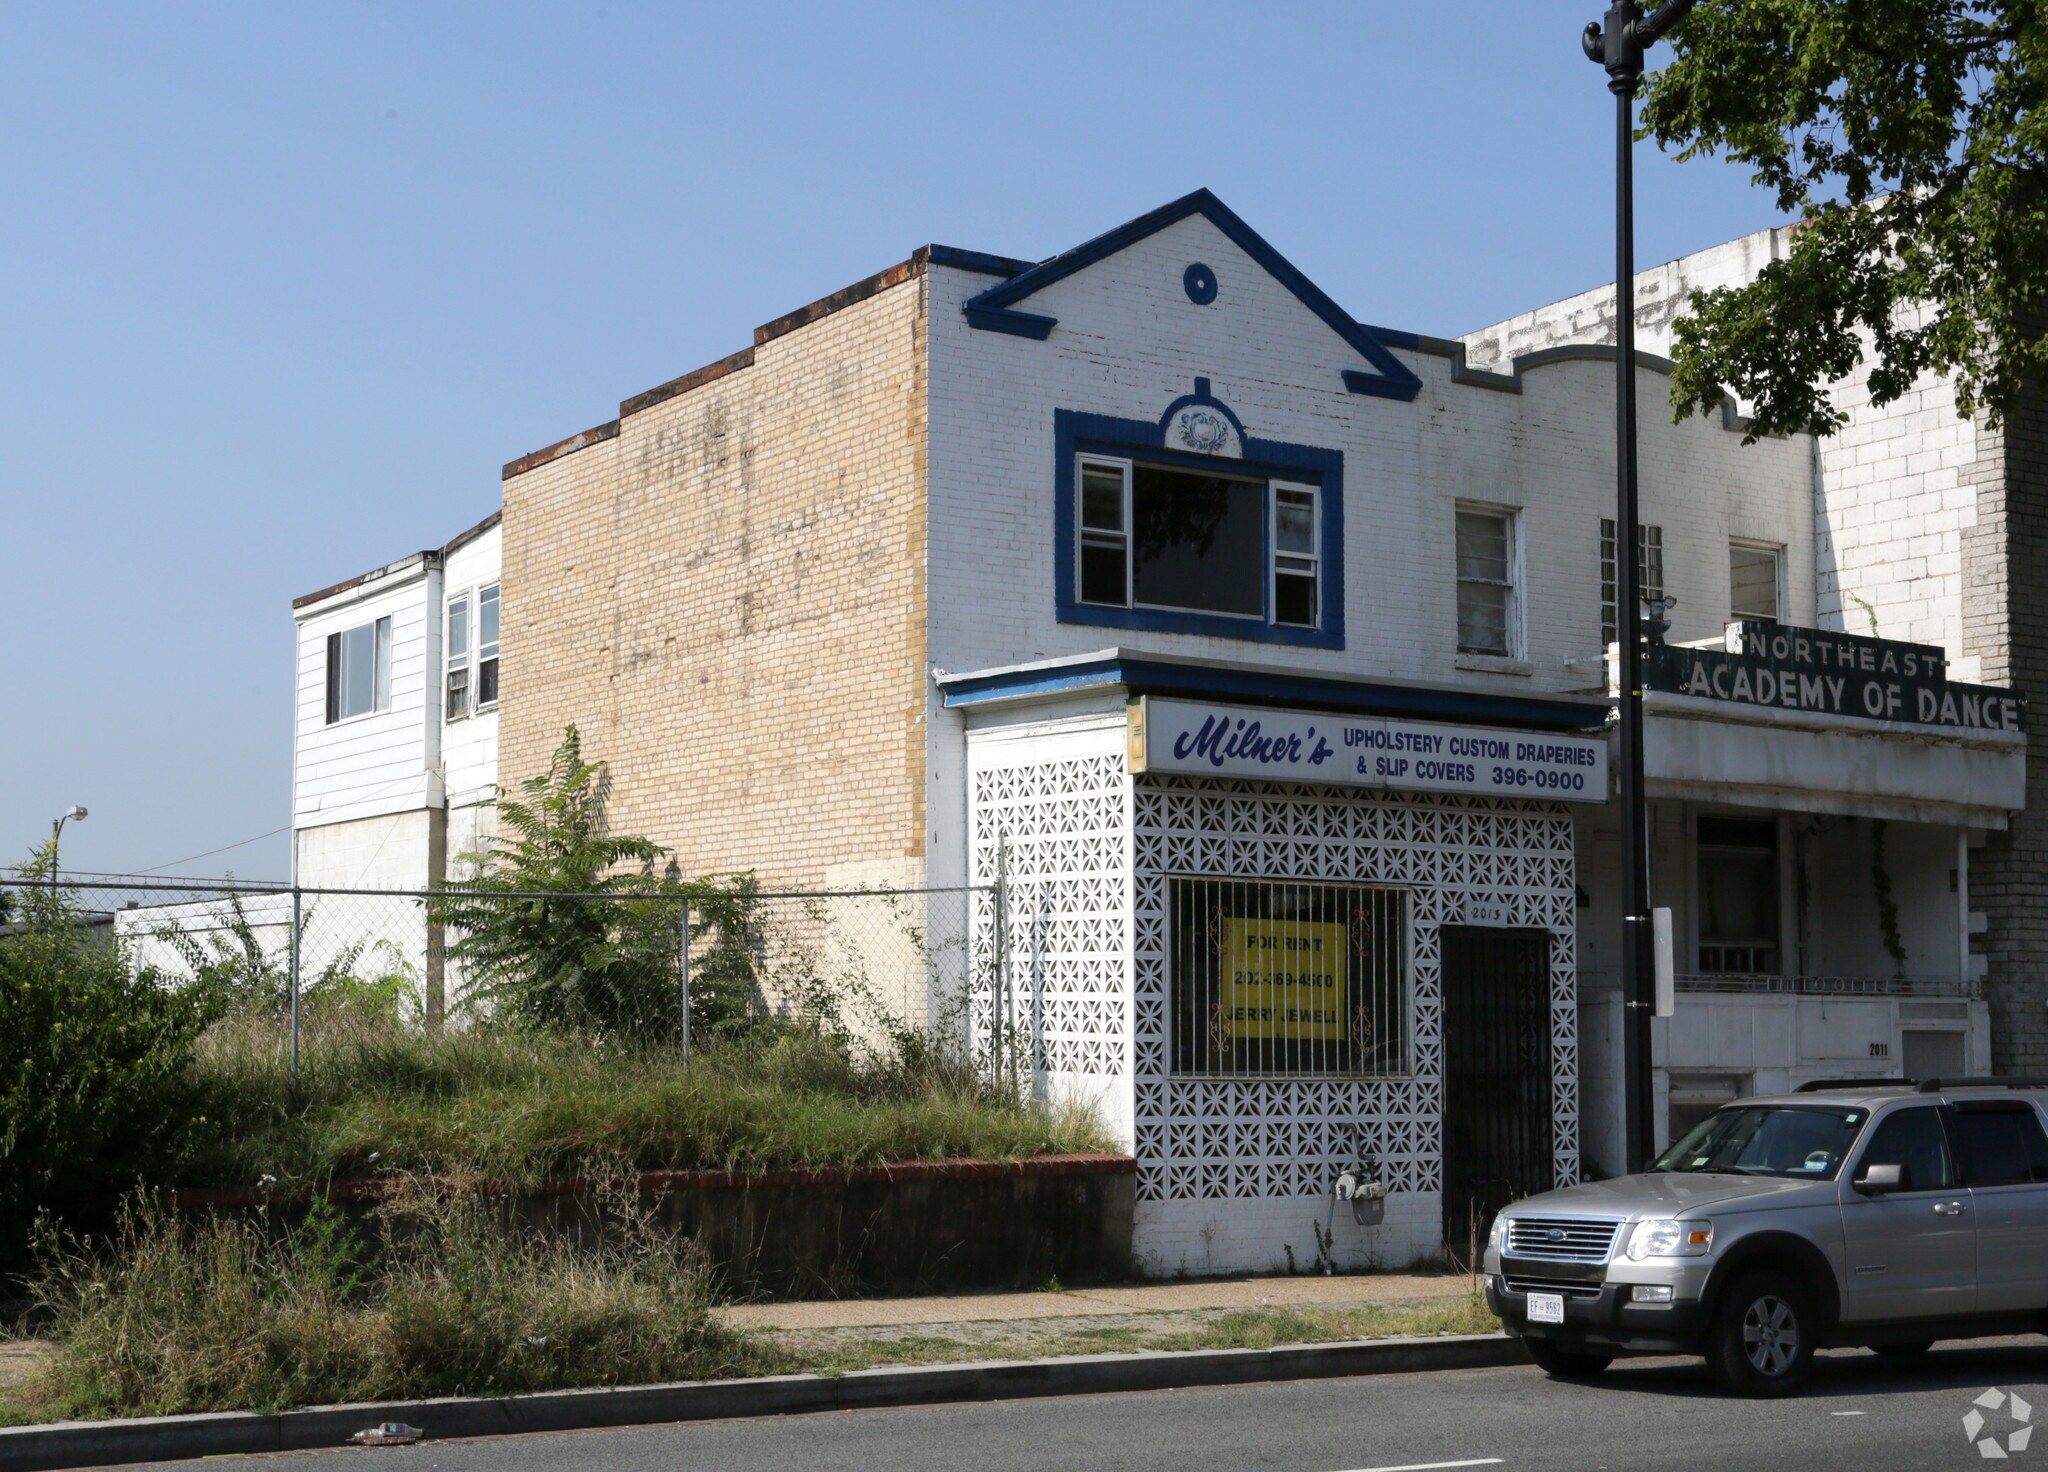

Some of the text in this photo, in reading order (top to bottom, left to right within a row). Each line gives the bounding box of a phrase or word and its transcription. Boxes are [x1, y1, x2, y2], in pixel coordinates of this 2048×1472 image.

[1750, 631, 1938, 678] NORTHEAST
[1689, 660, 2019, 731] ACADEMY OF DANCE
[1173, 714, 1334, 767] Milner's
[1344, 728, 1596, 767] UPHOLSTERY CUSTOM DRAPERIES
[1357, 755, 1584, 791] & SLIP COVERS 396-0900
[1247, 936, 1323, 952] FOR RENT
[1226, 1007, 1340, 1024] JERRY JEWELL
[1870, 1043, 1887, 1057] 2011
